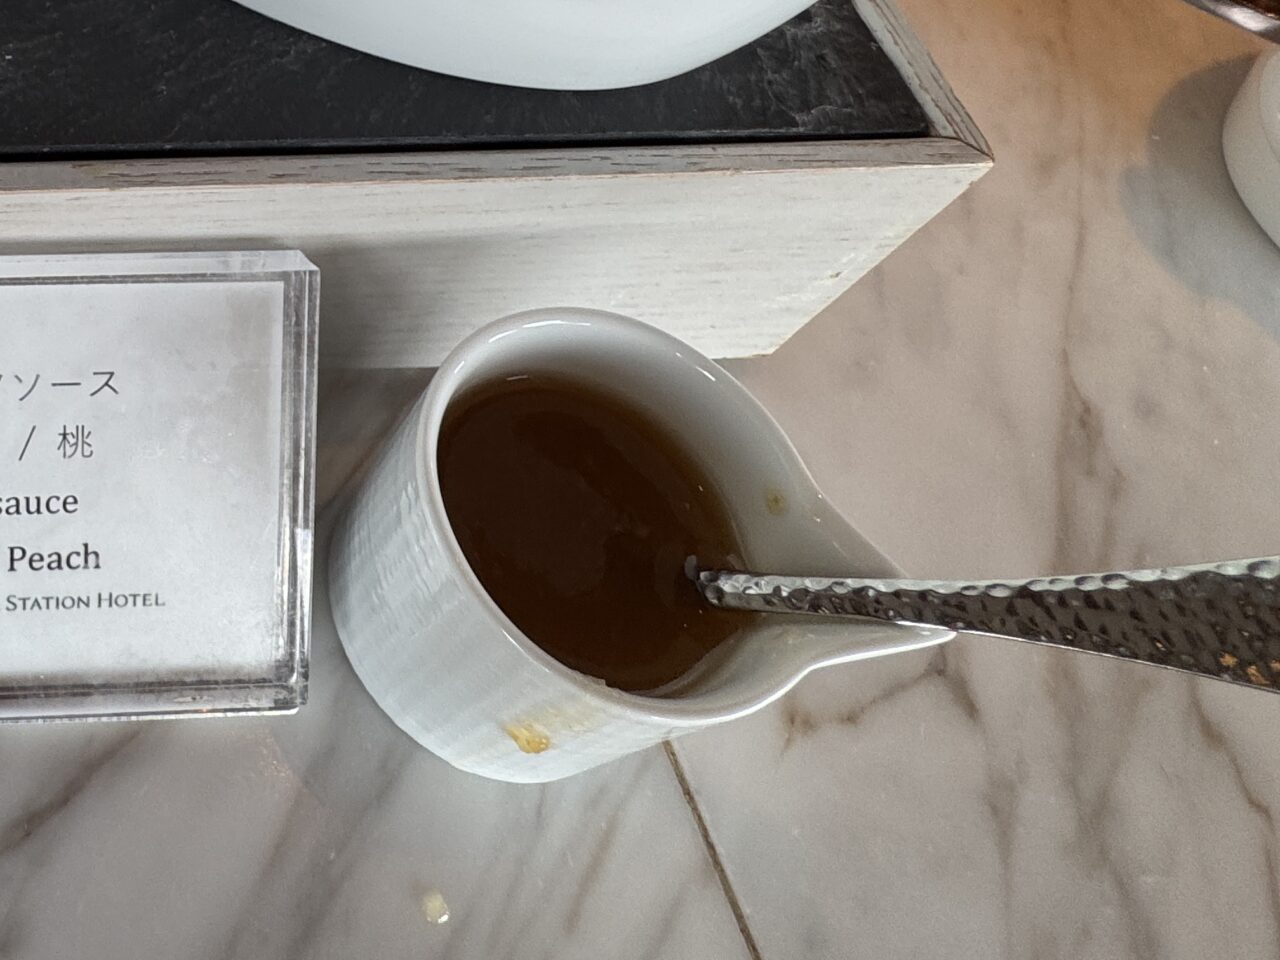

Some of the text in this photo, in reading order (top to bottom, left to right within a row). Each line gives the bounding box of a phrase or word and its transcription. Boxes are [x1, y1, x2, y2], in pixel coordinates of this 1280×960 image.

[56, 423, 95, 460] 桃
[6, 541, 102, 573] Peach
[5, 593, 91, 612] STATION
[95, 591, 166, 609] HOTEL
